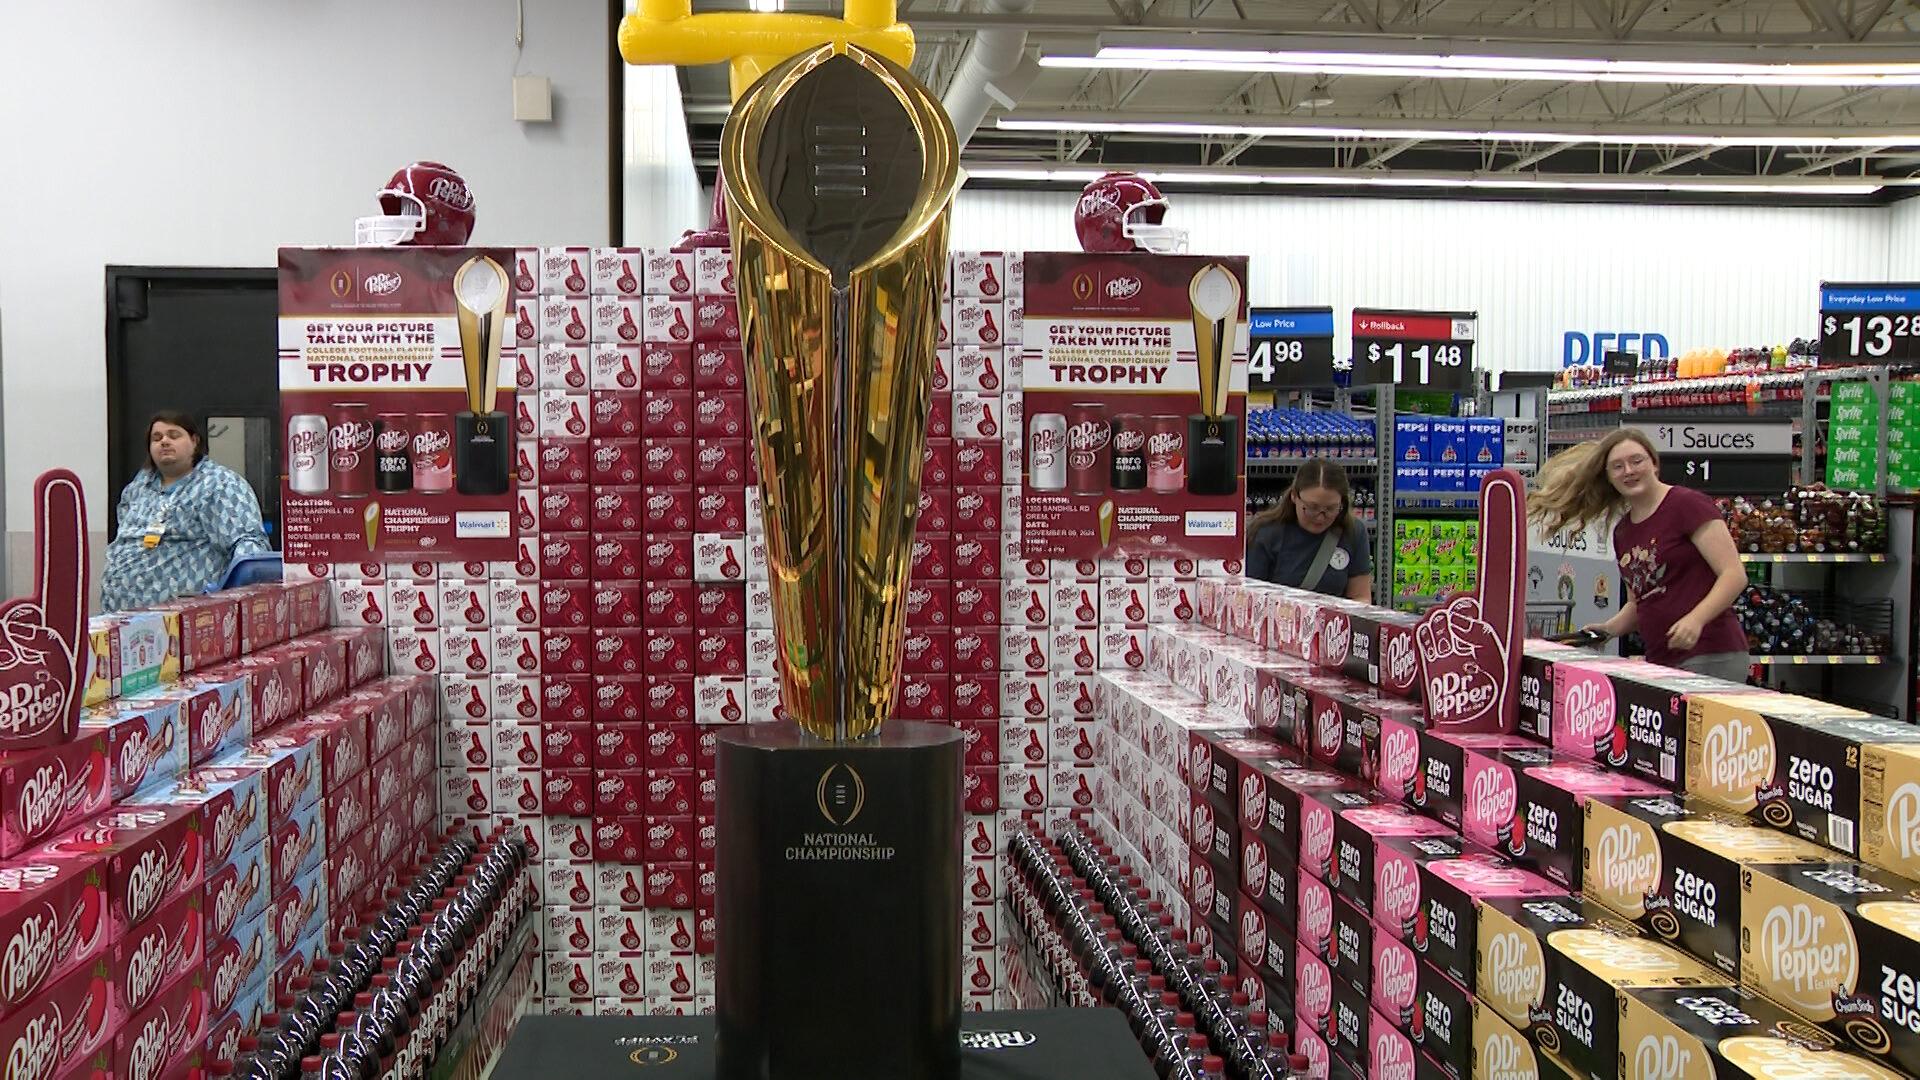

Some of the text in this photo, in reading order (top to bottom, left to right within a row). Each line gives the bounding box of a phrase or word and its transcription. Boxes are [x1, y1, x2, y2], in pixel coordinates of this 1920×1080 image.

[368, 275, 401, 294] Pepper
[1828, 295, 1906, 305] Everyday Low Price
[307, 323, 434, 332] GET YOUR PICTURE
[1050, 325, 1171, 336] GET YOUR PICTURE
[1255, 319, 1295, 328] Low Price
[1370, 321, 1405, 330] Rollback
[307, 334, 435, 344] TAKEN WITH THE
[1050, 335, 1171, 347] TAKEN WITH THE
[1048, 355, 1170, 364] NATIONAL CHAMPIONSHIP
[308, 363, 433, 382] TROPHY
[1049, 365, 1168, 384] TROPHY
[1838, 385, 1864, 401] Sprite
[1889, 384, 1906, 398] rite
[1836, 405, 1863, 421] Sprite
[331, 426, 372, 451] Pepper
[1397, 423, 1428, 432] PEPSI
[1434, 423, 1465, 433] PEPSI
[1470, 425, 1501, 434] PEPSI
[1507, 425, 1537, 434] PEPSI
[1683, 427, 1754, 449] Sauces
[1835, 427, 1861, 443] Sprite
[380, 456, 407, 465] zero
[1115, 456, 1142, 465] zero
[1834, 447, 1860, 463] Sprite
[380, 464, 407, 472] SUGAR
[1397, 468, 1428, 476] PEPSI
[1433, 469, 1465, 478] PEPSI
[1832, 468, 1859, 484] Sprite
[384, 507, 428, 516] NATIONAL
[384, 516, 450, 524] CHAMPIONSHIP
[1118, 506, 1160, 515] NATIONAL
[384, 524, 421, 533] TROPHY
[459, 521, 496, 529] Walmart
[1187, 519, 1223, 529] Walmart
[1548, 530, 1586, 551] auces
[1443, 671, 1473, 694] Dr
[1582, 679, 1600, 706] Dr
[10, 683, 45, 709] Dr
[1431, 676, 1493, 719] Pepper
[0, 690, 60, 733] epper
[1566, 685, 1611, 738] Pepper
[1630, 704, 1662, 730] zero
[1397, 729, 1409, 754] Dr
[1630, 725, 1662, 747] SUGAR
[1728, 719, 1752, 756] Dr
[1385, 732, 1415, 781] Pepper
[1427, 757, 1451, 781] zero
[1706, 724, 1769, 791] Pepper
[36, 766, 53, 798] Dr
[1487, 767, 1503, 791] Dr
[1789, 755, 1834, 790] zero
[1426, 775, 1450, 797] SUGAR
[1788, 781, 1833, 812] SUGAR
[20, 772, 64, 835] Pepper
[1474, 774, 1512, 825] Pepper
[1528, 801, 1558, 830] zero
[804, 833, 878, 846] NATIONAL
[1527, 823, 1557, 850] SUGAR
[1619, 824, 1641, 860] Dr
[141, 850, 156, 881] Dr
[785, 846, 895, 860] CHAMPIONSHIP
[1599, 827, 1655, 896] Pepper
[1392, 859, 1408, 887] Dr
[128, 855, 165, 920] Pepper
[1381, 861, 1416, 917] Pepper
[1675, 868, 1716, 907] zero
[1430, 899, 1456, 931] zero
[1674, 894, 1716, 927] SUGAR
[22, 914, 42, 951] Dr
[1430, 919, 1456, 949] SUGAR
[1793, 903, 1825, 948] Dr
[142, 934, 156, 966] Dr
[1392, 947, 1406, 972] Dr
[1507, 932, 1527, 964] Dr
[1763, 905, 1848, 992] Pepper
[3, 919, 54, 1003] Pepper
[128, 938, 165, 1007] Pepper
[1489, 933, 1540, 1003] Pepper
[1380, 948, 1414, 1003] Pepper
[1425, 991, 1452, 1027] zero
[1557, 984, 1593, 1027] zero
[1425, 1011, 1451, 1045] SUGAR
[1556, 1011, 1593, 1048] SUGAR
[1661, 1035, 1691, 1080] Dr
